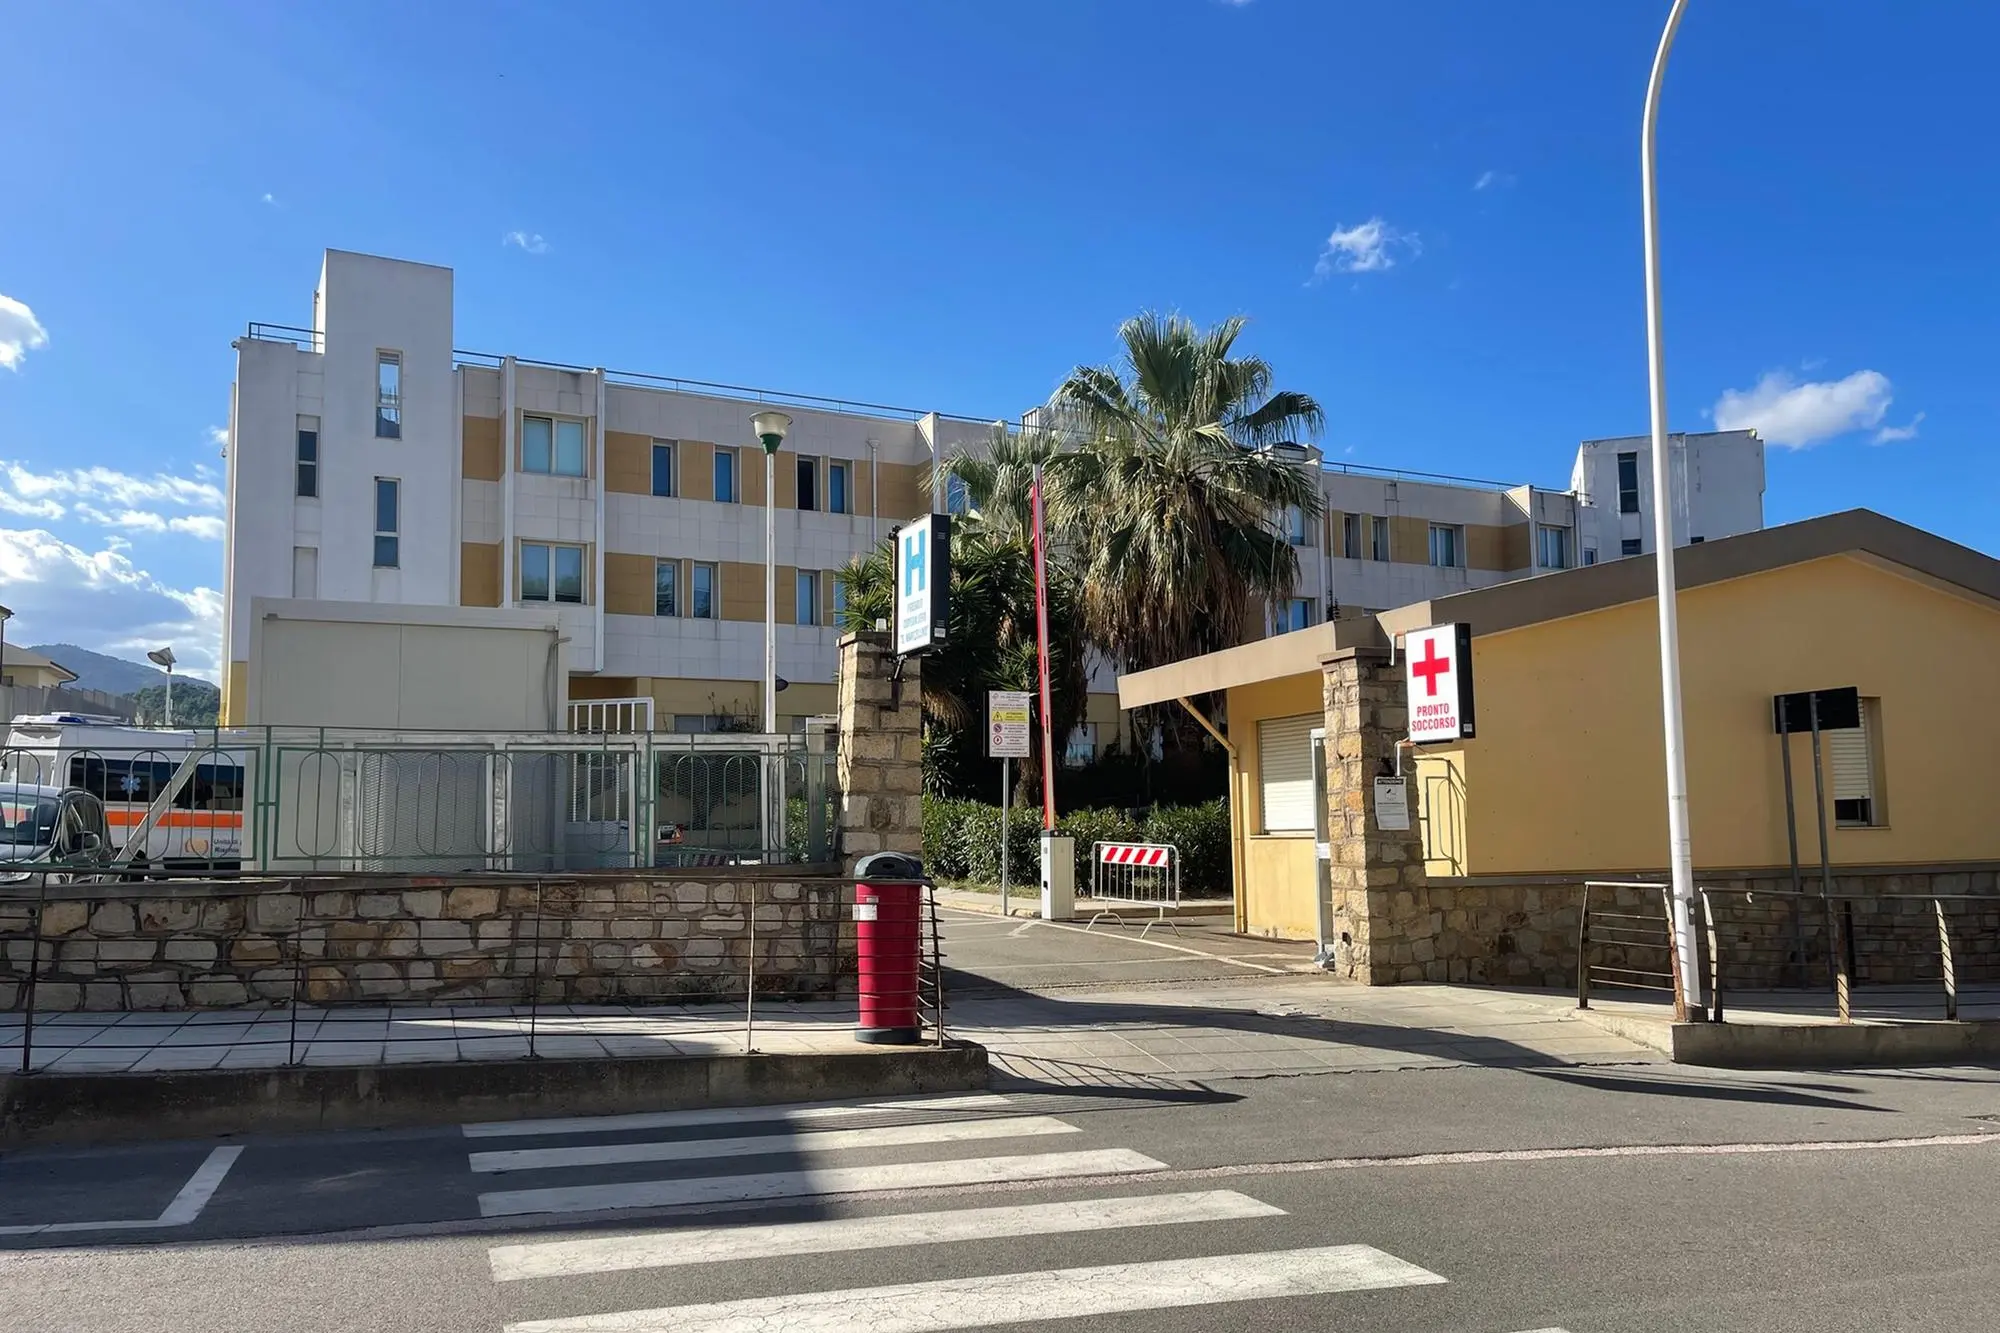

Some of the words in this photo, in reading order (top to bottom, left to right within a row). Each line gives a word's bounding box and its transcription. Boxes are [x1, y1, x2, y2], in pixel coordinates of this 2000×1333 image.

[905, 529, 925, 597] H
[1417, 703, 1449, 717] PRONTO
[1412, 716, 1456, 732] SOCCORSO
